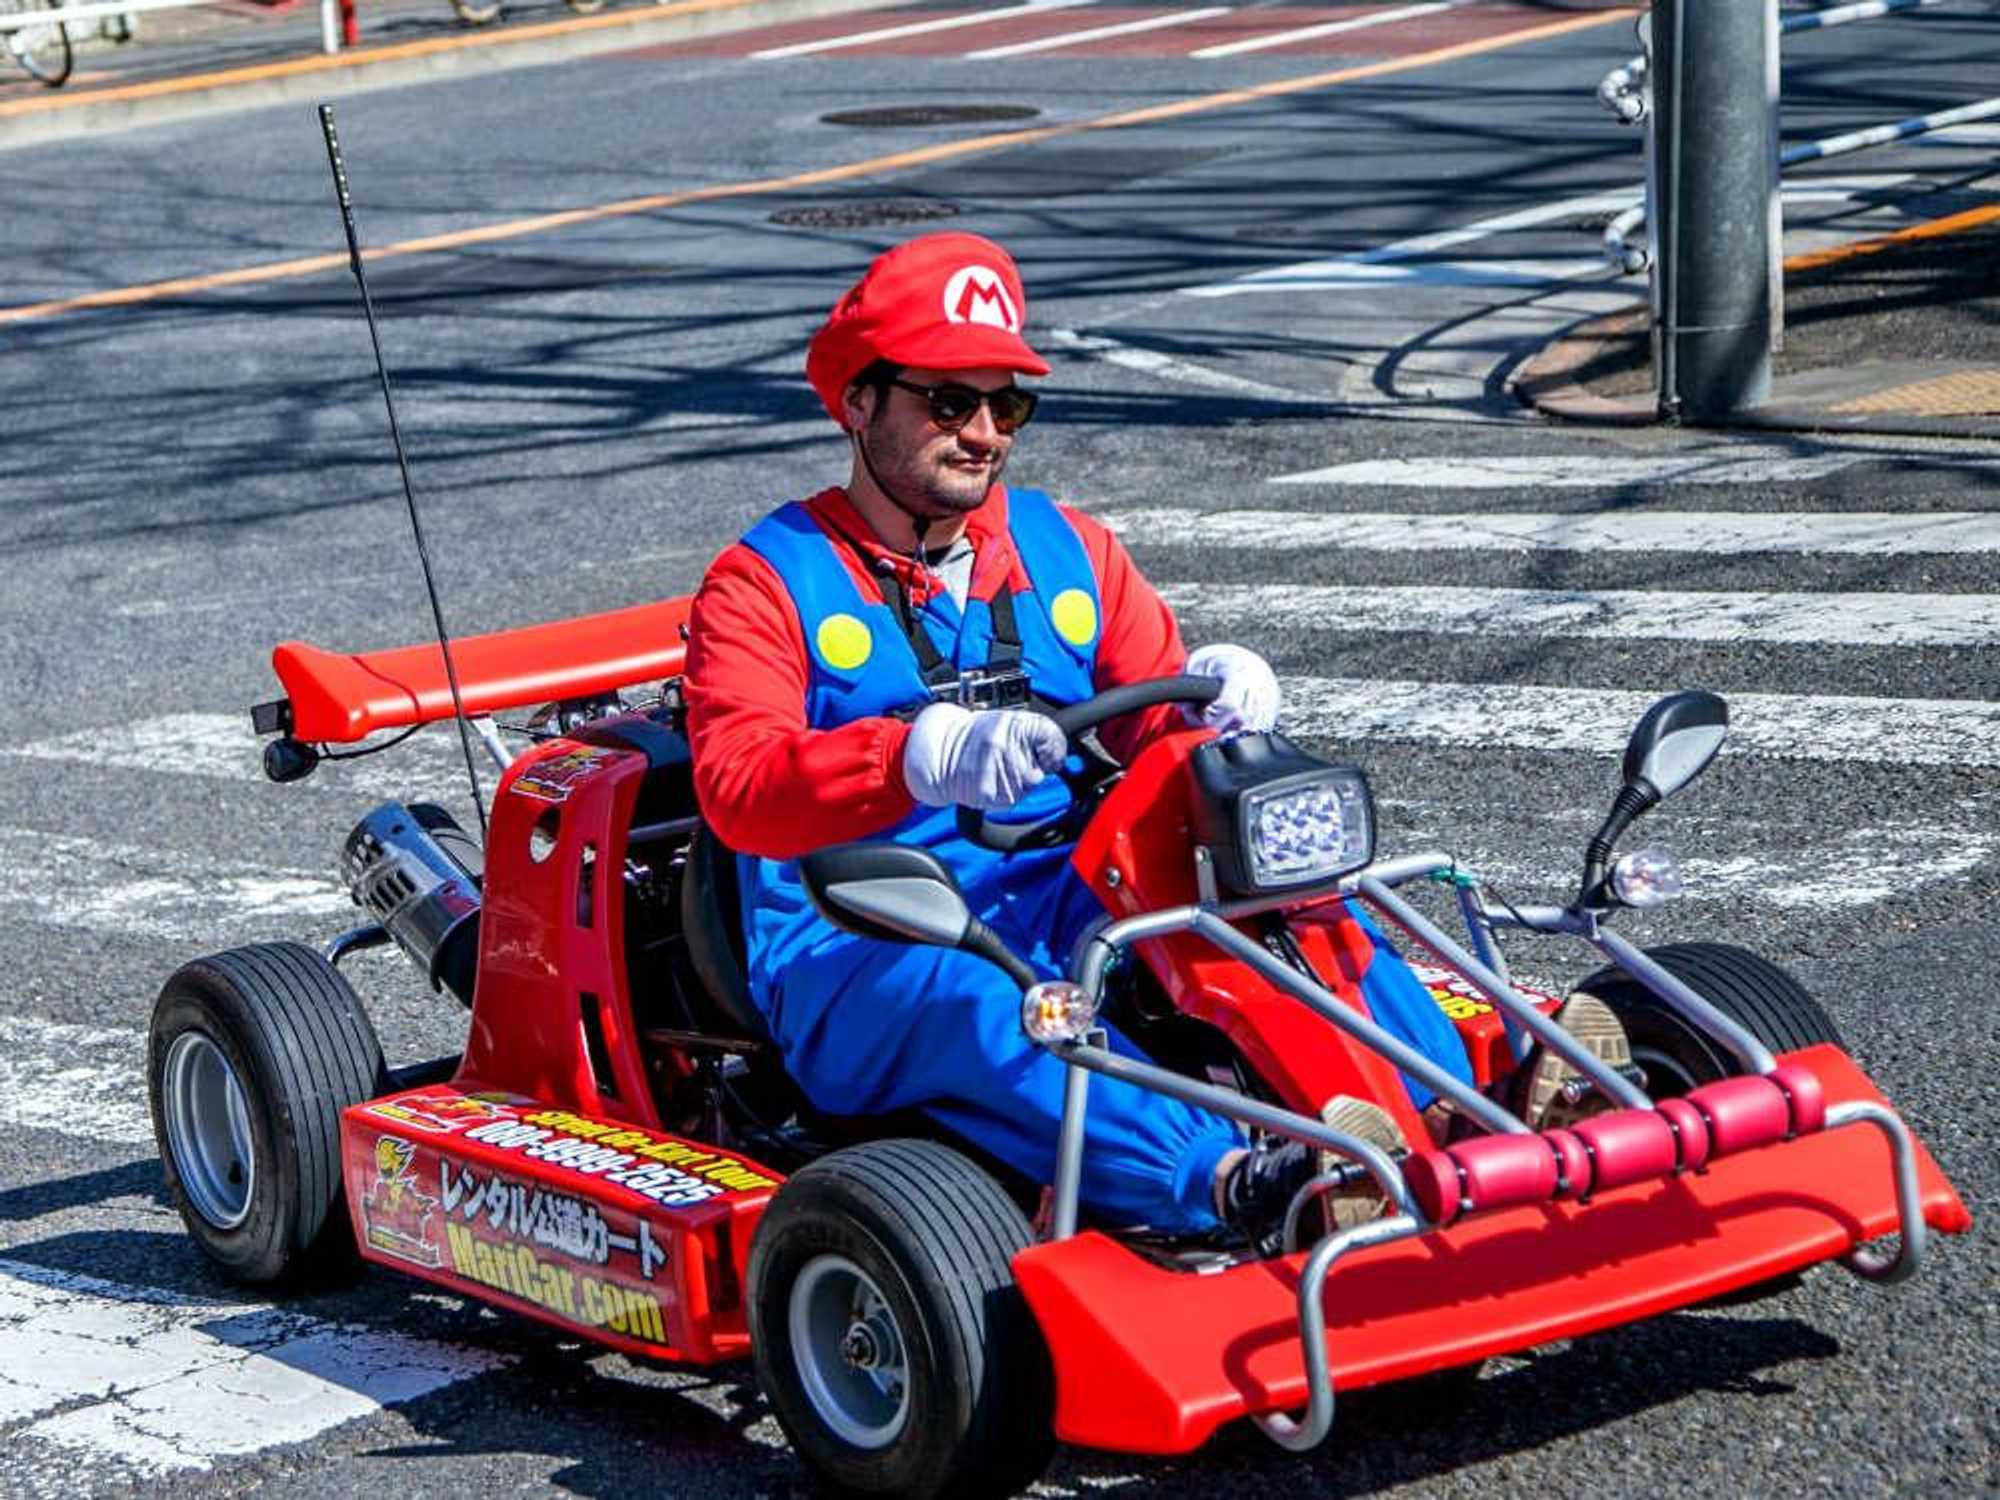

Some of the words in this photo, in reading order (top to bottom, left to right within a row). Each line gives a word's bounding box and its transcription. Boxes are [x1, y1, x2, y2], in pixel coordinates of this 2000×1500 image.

[954, 276, 1013, 328] M
[464, 1119, 724, 1206] 080-9999-2525
[691, 1158, 779, 1191] Tour
[440, 1160, 667, 1278] レンタル公道カート
[447, 1221, 669, 1344] MariCar.com
